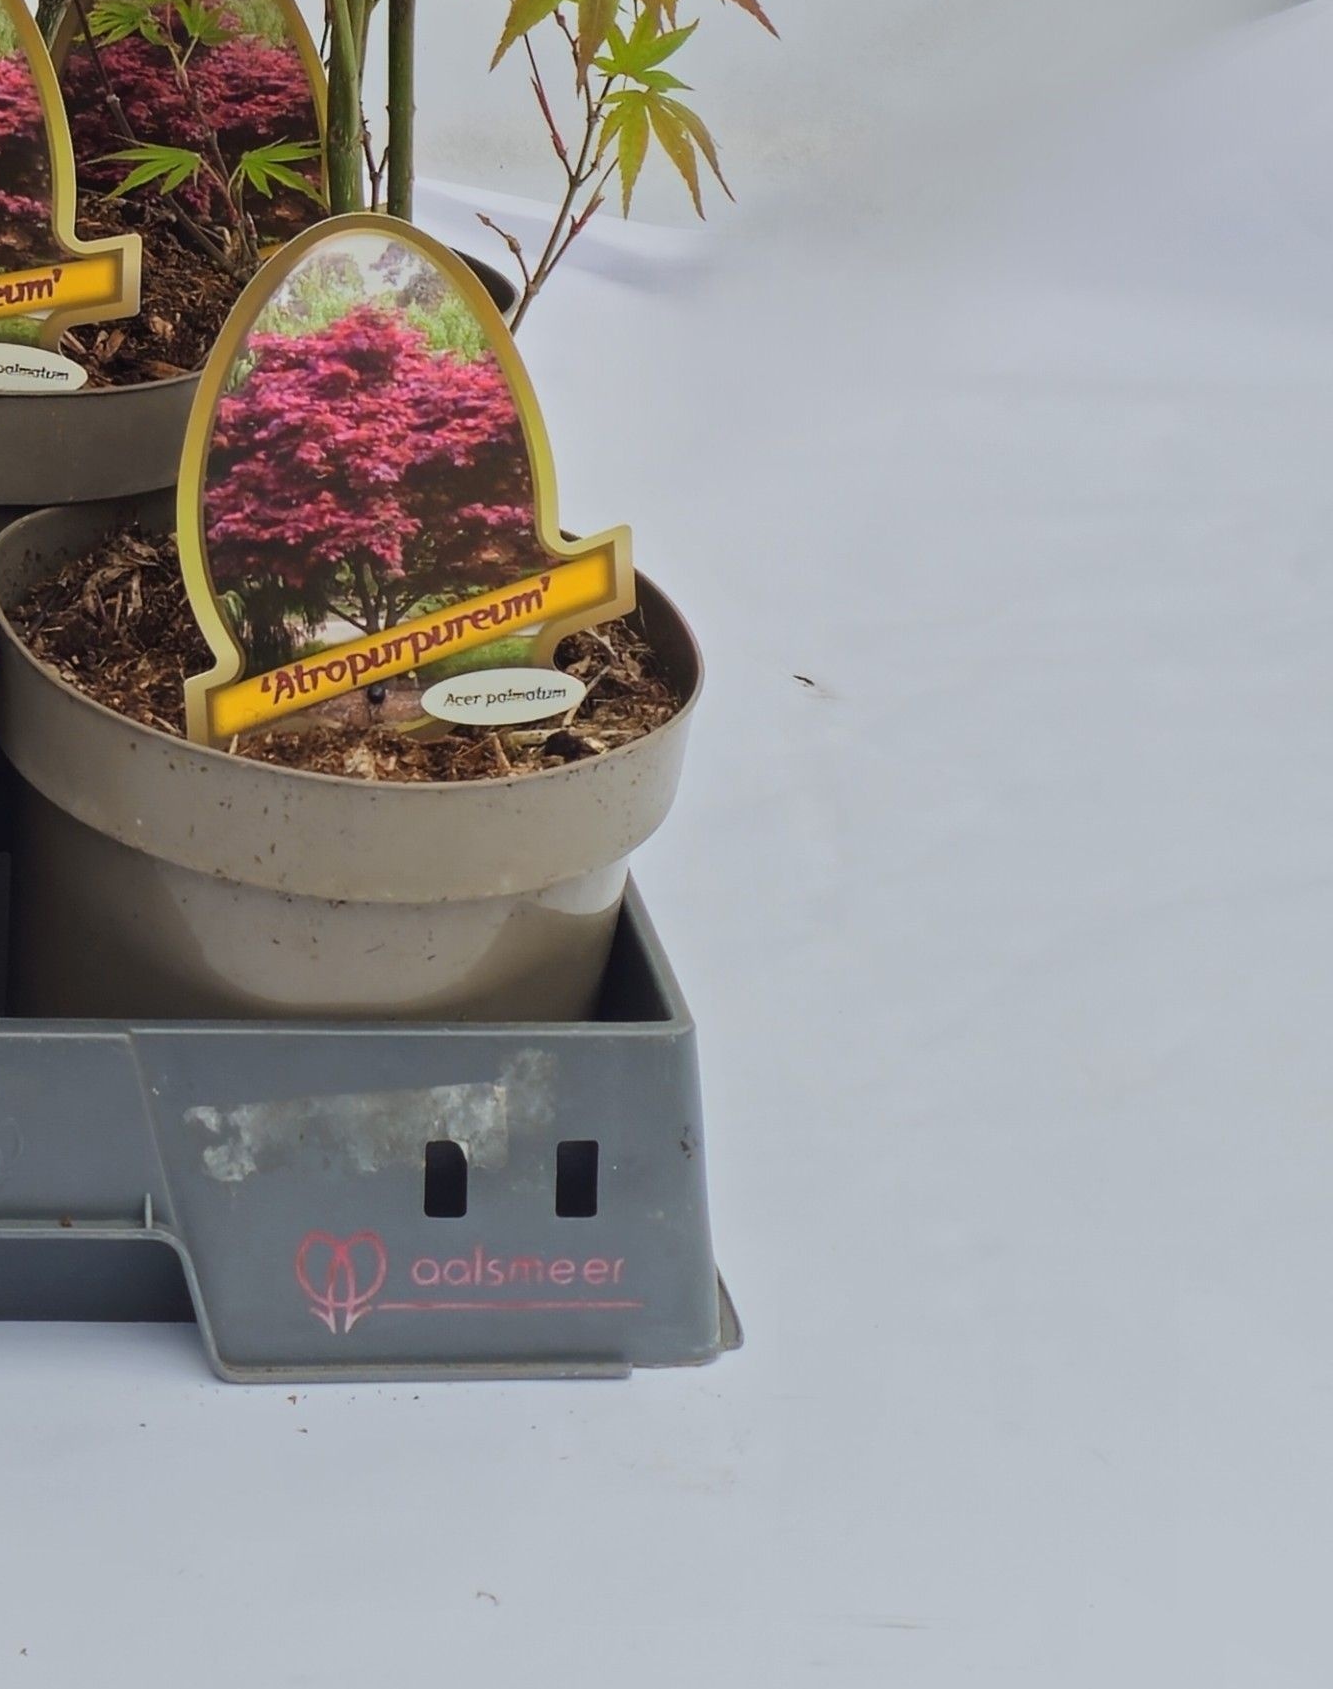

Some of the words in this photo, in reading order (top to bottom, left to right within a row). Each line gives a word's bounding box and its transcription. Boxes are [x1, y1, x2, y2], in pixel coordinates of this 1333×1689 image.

[443, 690, 482, 707] Acer
[486, 686, 567, 707] palmatum
[411, 1246, 625, 1287] aalsmeer
